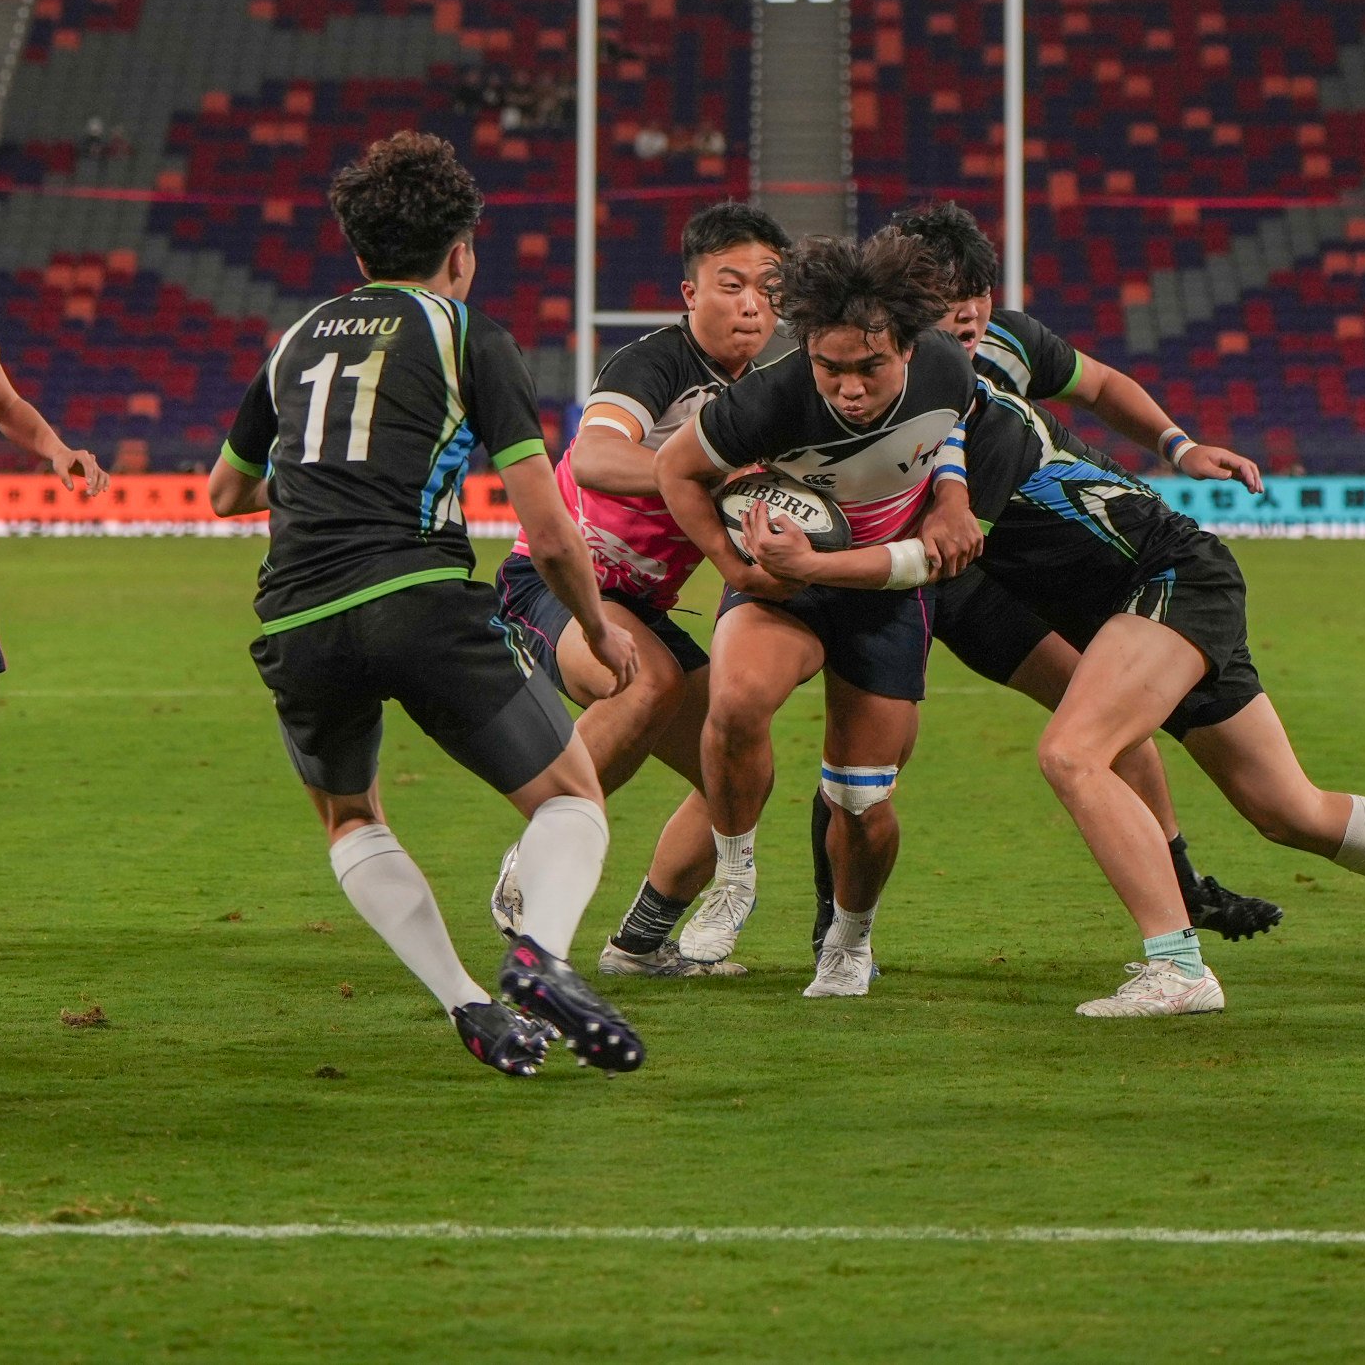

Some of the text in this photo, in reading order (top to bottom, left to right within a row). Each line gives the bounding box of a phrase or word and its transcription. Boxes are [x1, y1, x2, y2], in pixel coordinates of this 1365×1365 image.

[312, 316, 403, 339] HKMU
[300, 350, 386, 465] 11
[721, 480, 821, 523] GILBERT
